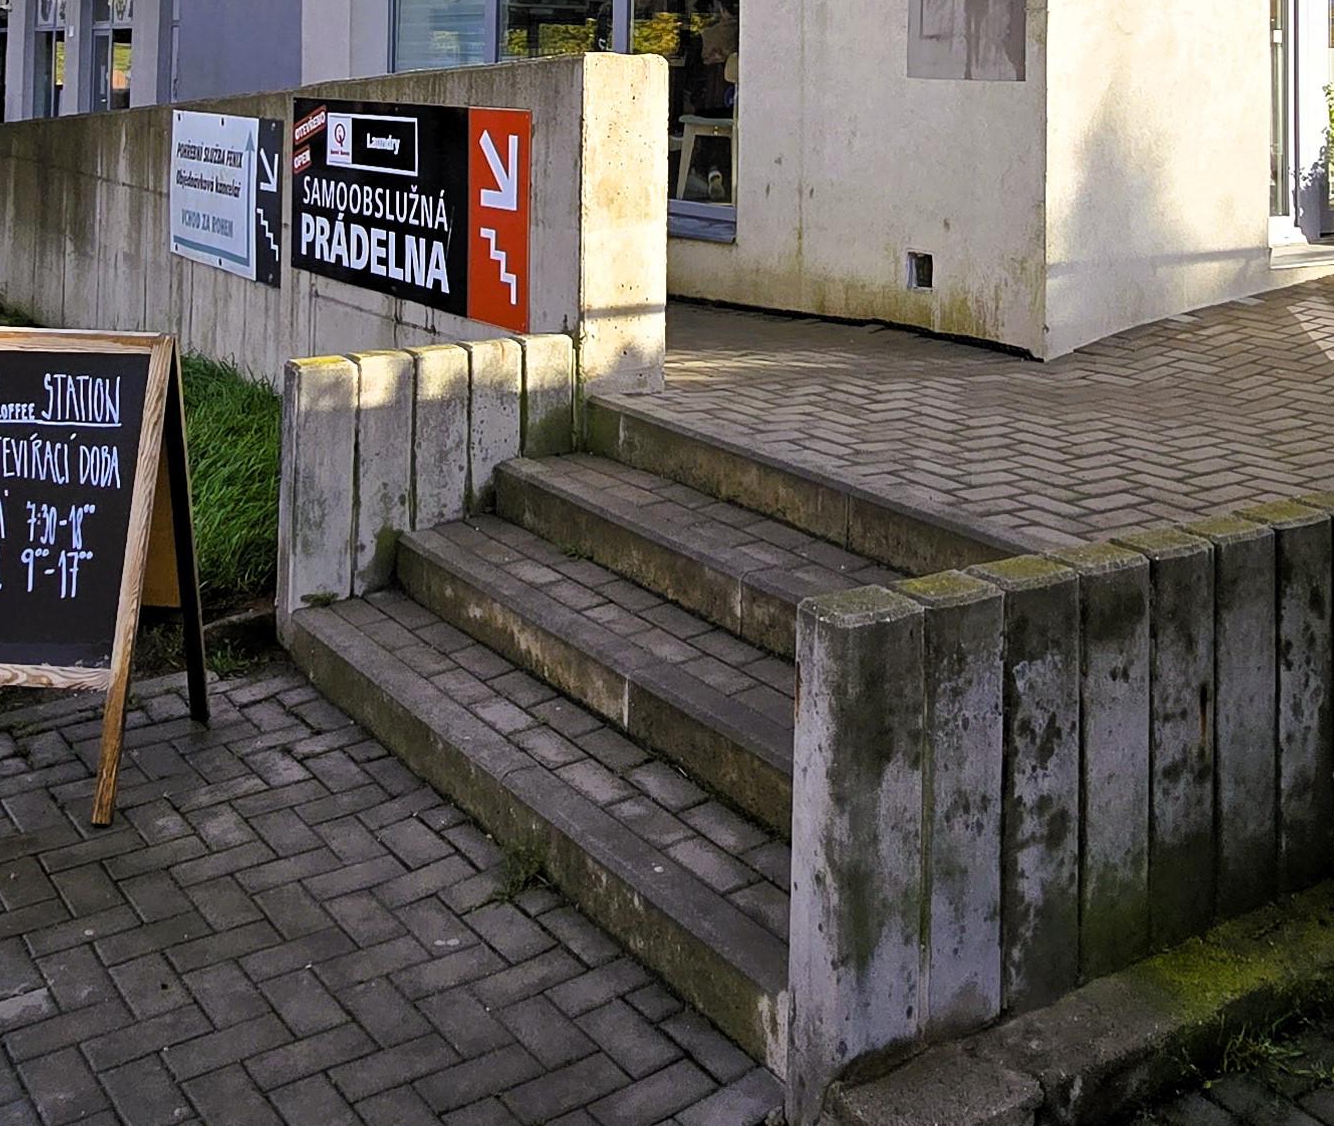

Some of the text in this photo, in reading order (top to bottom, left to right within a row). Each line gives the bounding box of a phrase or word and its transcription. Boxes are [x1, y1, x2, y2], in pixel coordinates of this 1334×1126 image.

[204, 144, 225, 165] SLUŽBA
[294, 149, 311, 169] OPEN
[367, 132, 400, 155] Laundry
[181, 208, 201, 230] VCHOD
[201, 214, 210, 232] ZA
[302, 175, 448, 232] SAMOOBSLUŽNÁ
[300, 212, 450, 294] PRÁDELNA
[42, 373, 122, 424] STATION
[79, 444, 121, 489] DOBA
